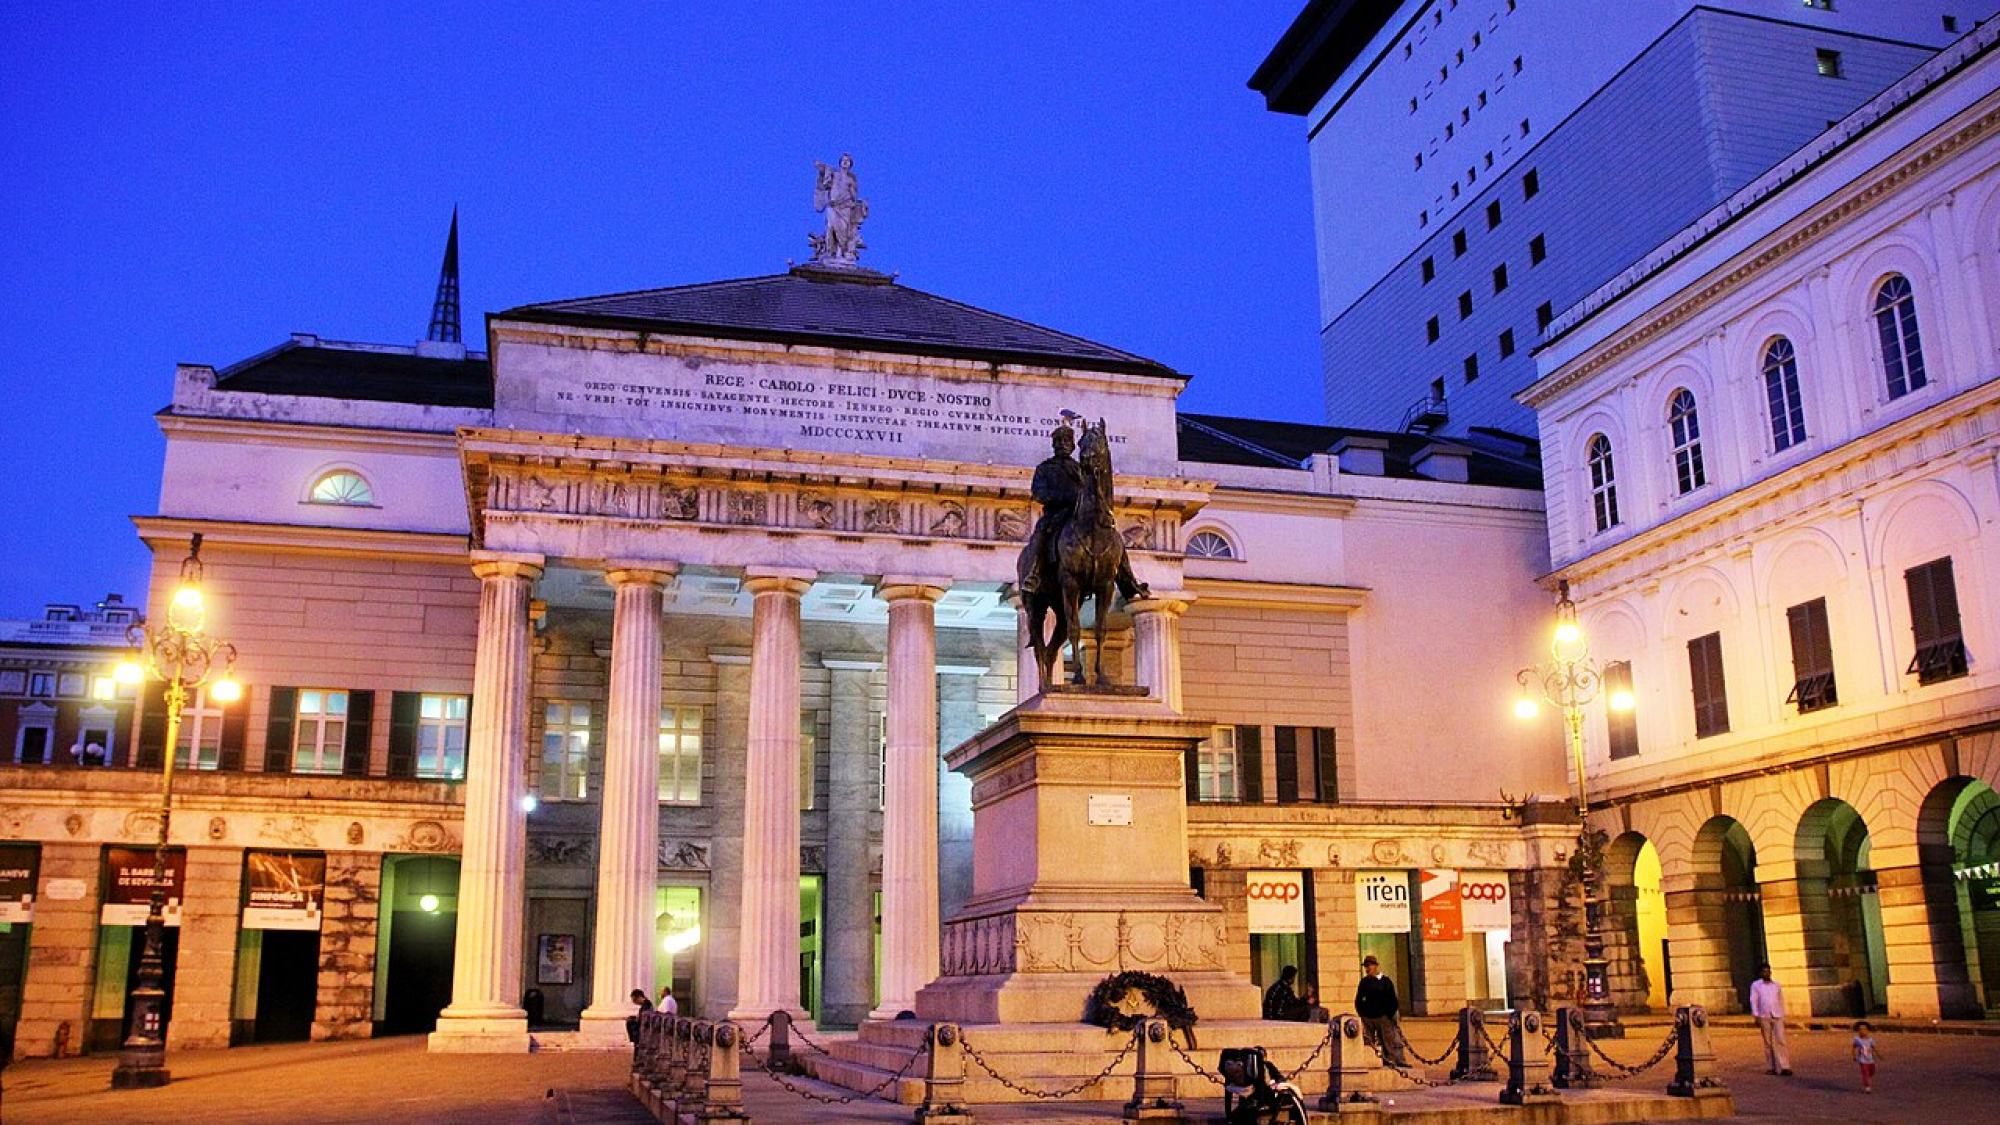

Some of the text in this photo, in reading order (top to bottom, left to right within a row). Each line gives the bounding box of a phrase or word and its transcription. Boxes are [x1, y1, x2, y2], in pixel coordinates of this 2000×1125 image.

[585, 382, 615, 391] ORDO
[780, 397, 835, 409] HECTORE
[904, 407, 939, 417] REGIO
[758, 379, 815, 393] CAROLO
[828, 384, 877, 398] FELICI
[888, 388, 926, 402] DVCE
[937, 393, 991, 407] NOSTRO
[557, 391, 573, 401] NE
[584, 394, 615, 404] VRBI
[626, 397, 650, 407] TOT
[660, 400, 732, 413] INSIGNIBVS
[743, 406, 825, 420] MONVMENTIS
[834, 413, 907, 427] INSTRVCTAE
[917, 420, 982, 432] THEATRVM
[800, 425, 903, 442] MDCCCXXVII
[1247, 882, 1299, 904] coop
[1366, 884, 1408, 901] iren
[1461, 882, 1506, 904] coop
